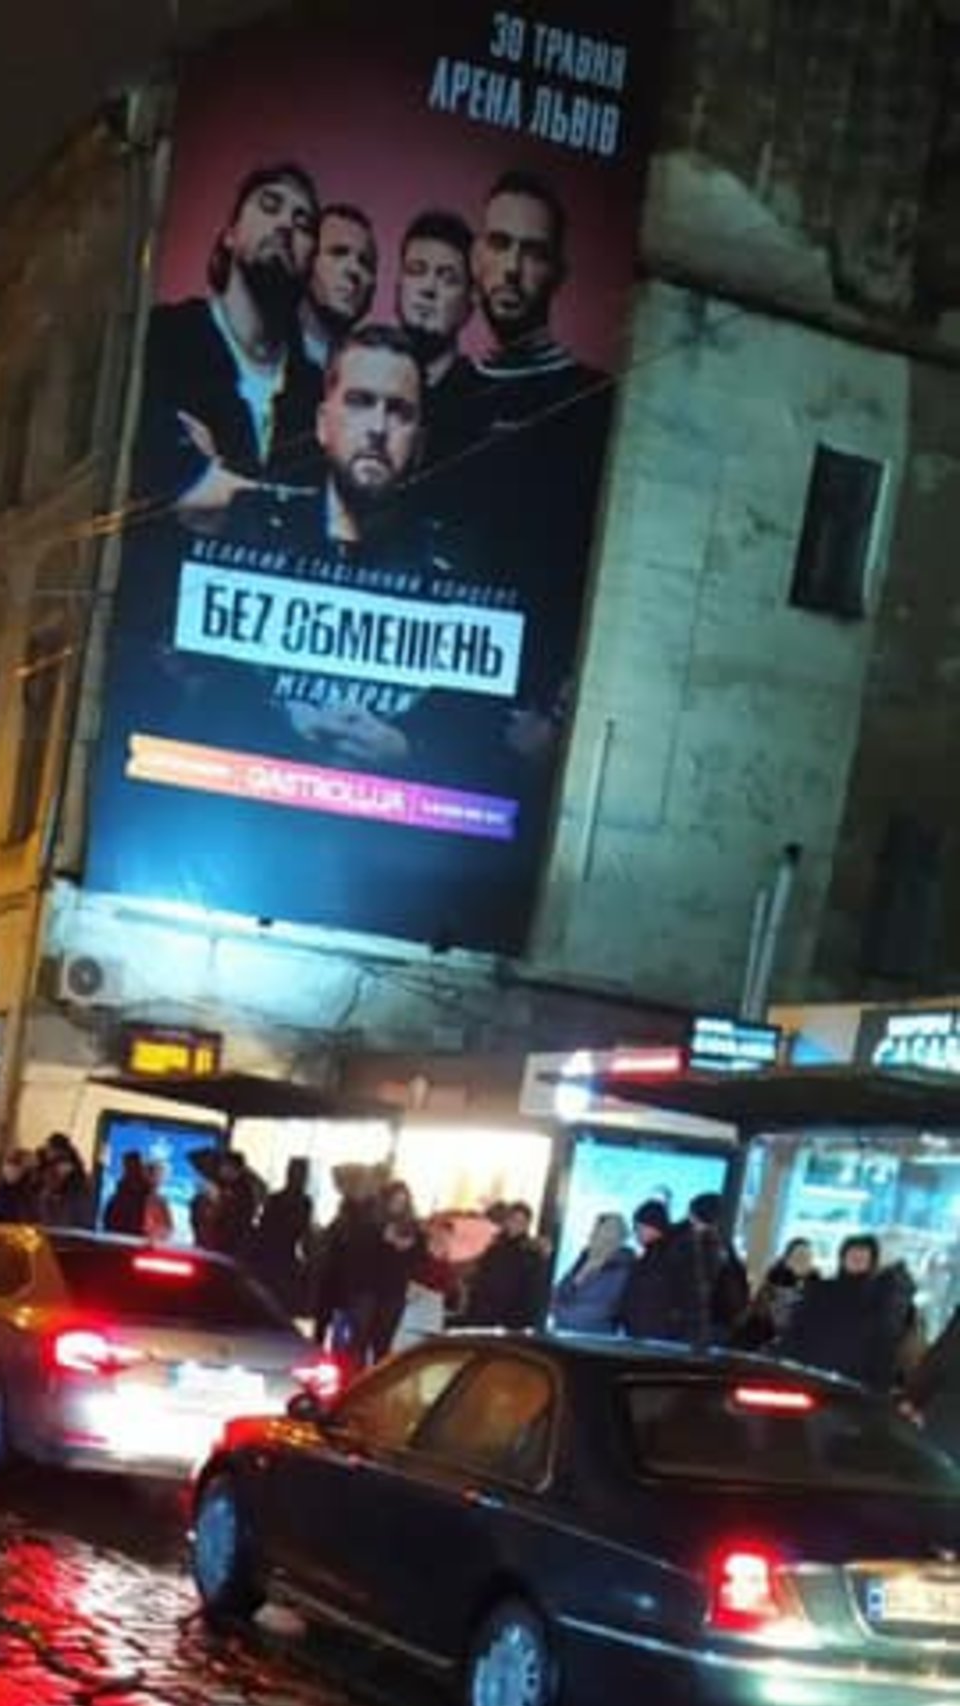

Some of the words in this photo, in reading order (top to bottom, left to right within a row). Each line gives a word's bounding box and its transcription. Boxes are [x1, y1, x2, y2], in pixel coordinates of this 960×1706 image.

[490, 12, 524, 62] 30
[533, 21, 628, 92] ТРАВНЯ
[428, 55, 521, 130] АРЕНА
[529, 84, 620, 156] ЛЬВІВ
